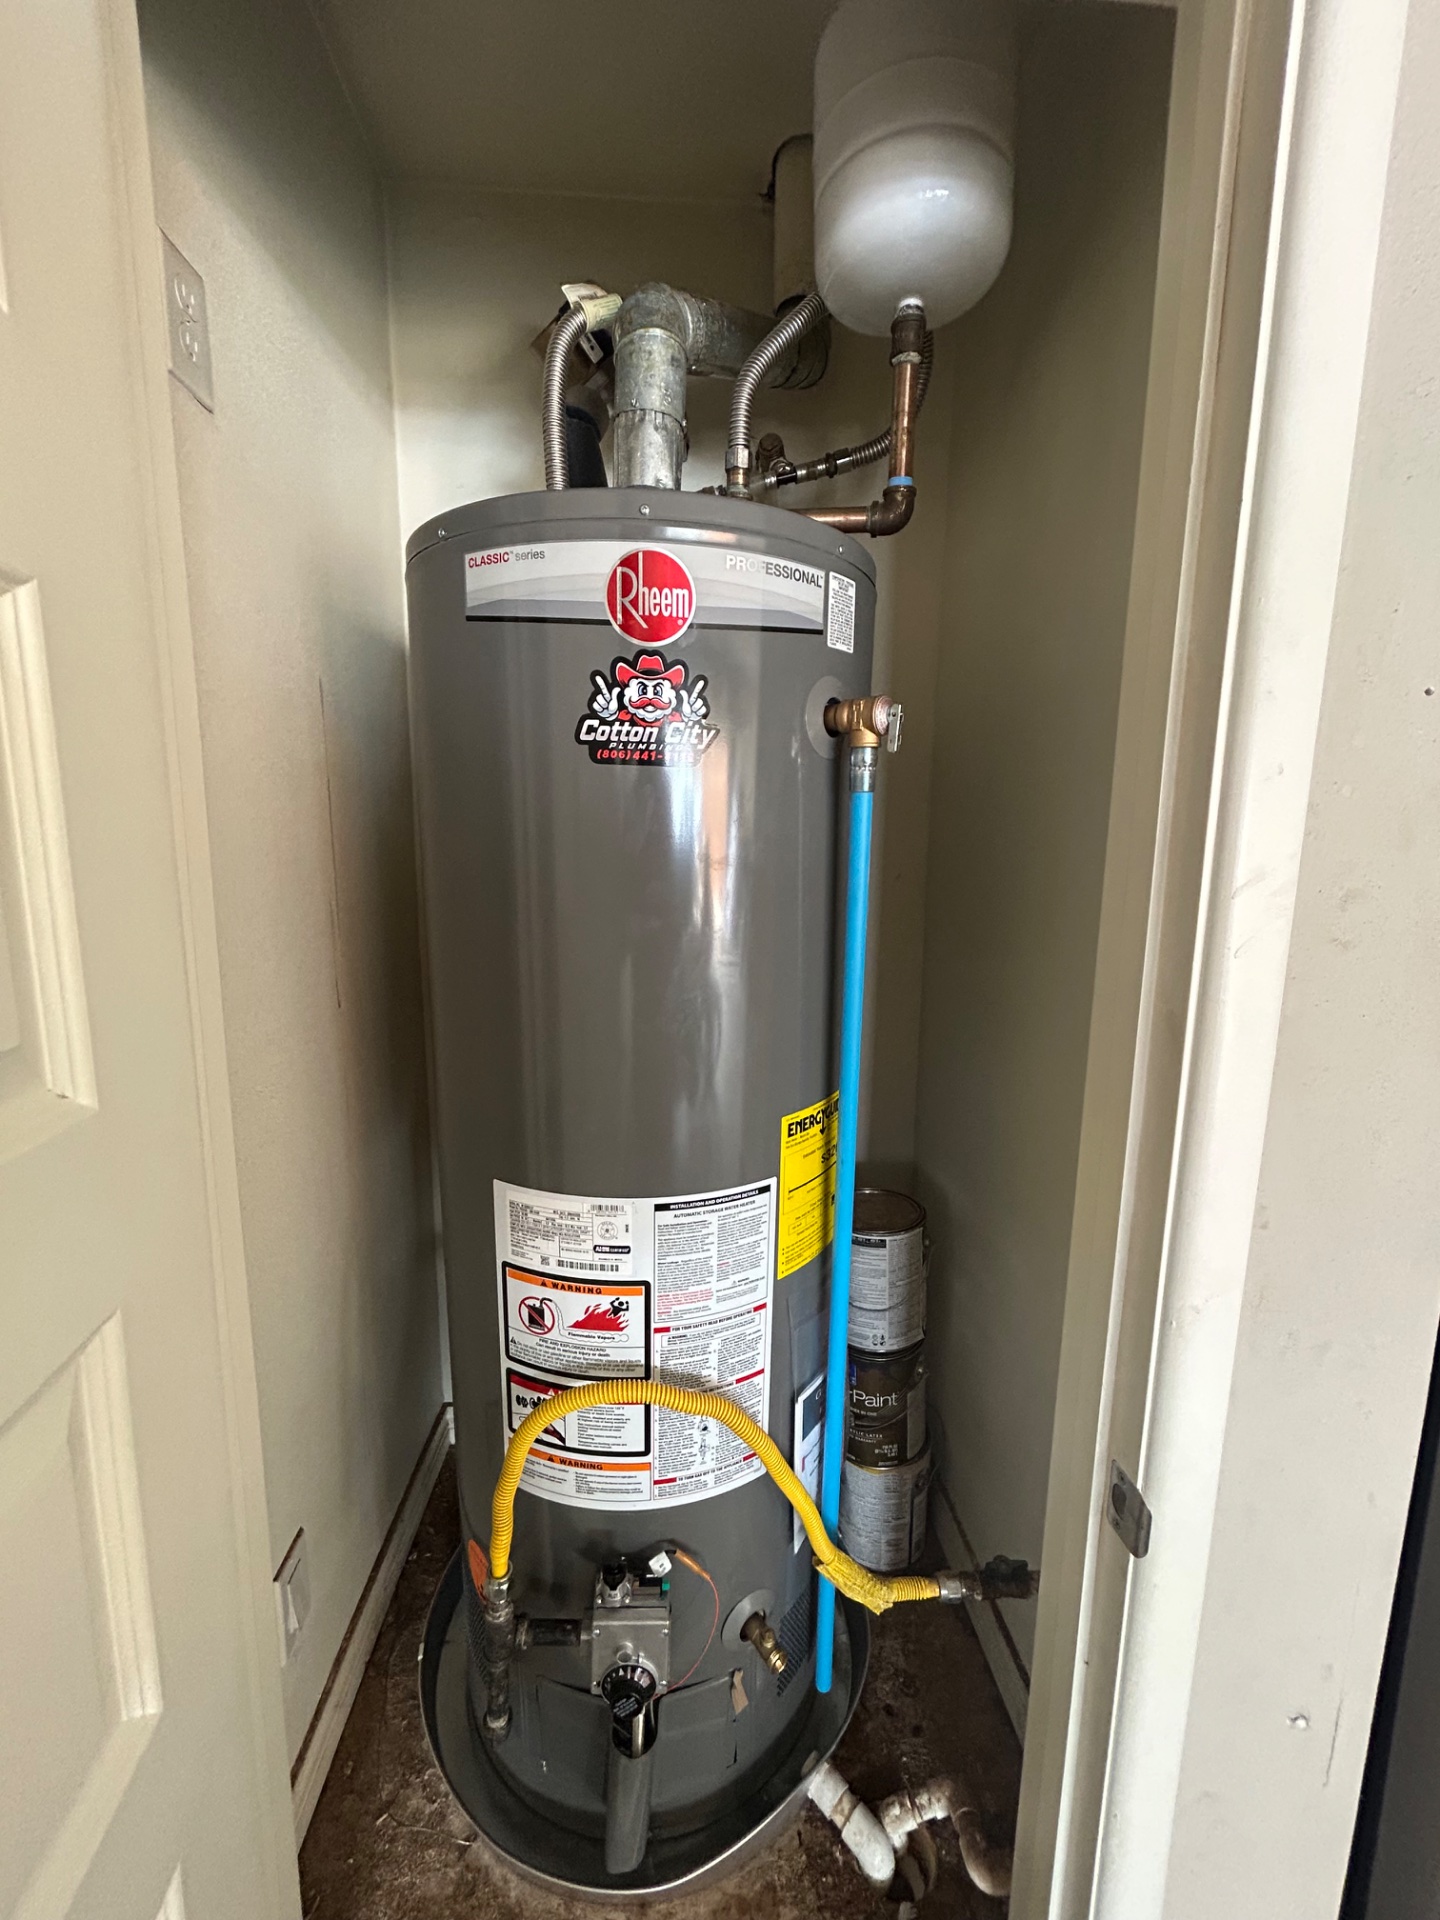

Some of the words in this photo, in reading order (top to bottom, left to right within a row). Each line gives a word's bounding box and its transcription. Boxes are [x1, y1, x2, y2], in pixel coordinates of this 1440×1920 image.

[468, 551, 510, 568] CLASSIC
[515, 549, 545, 561] series
[616, 551, 689, 629] Rheem
[579, 719, 659, 742] Cotton
[664, 720, 716, 749] City
[596, 749, 694, 761] (806)441-
[670, 1201, 704, 1210] INSTALLATION
[716, 1194, 742, 1203] OPERATION
[673, 1210, 702, 1218] AUTOMATIC
[703, 1207, 723, 1215] STORAGE
[740, 1200, 756, 1208] HEATER
[552, 1281, 602, 1294] WARNING
[850, 1389, 898, 1407] Paint
[559, 1457, 603, 1470] WARNING
